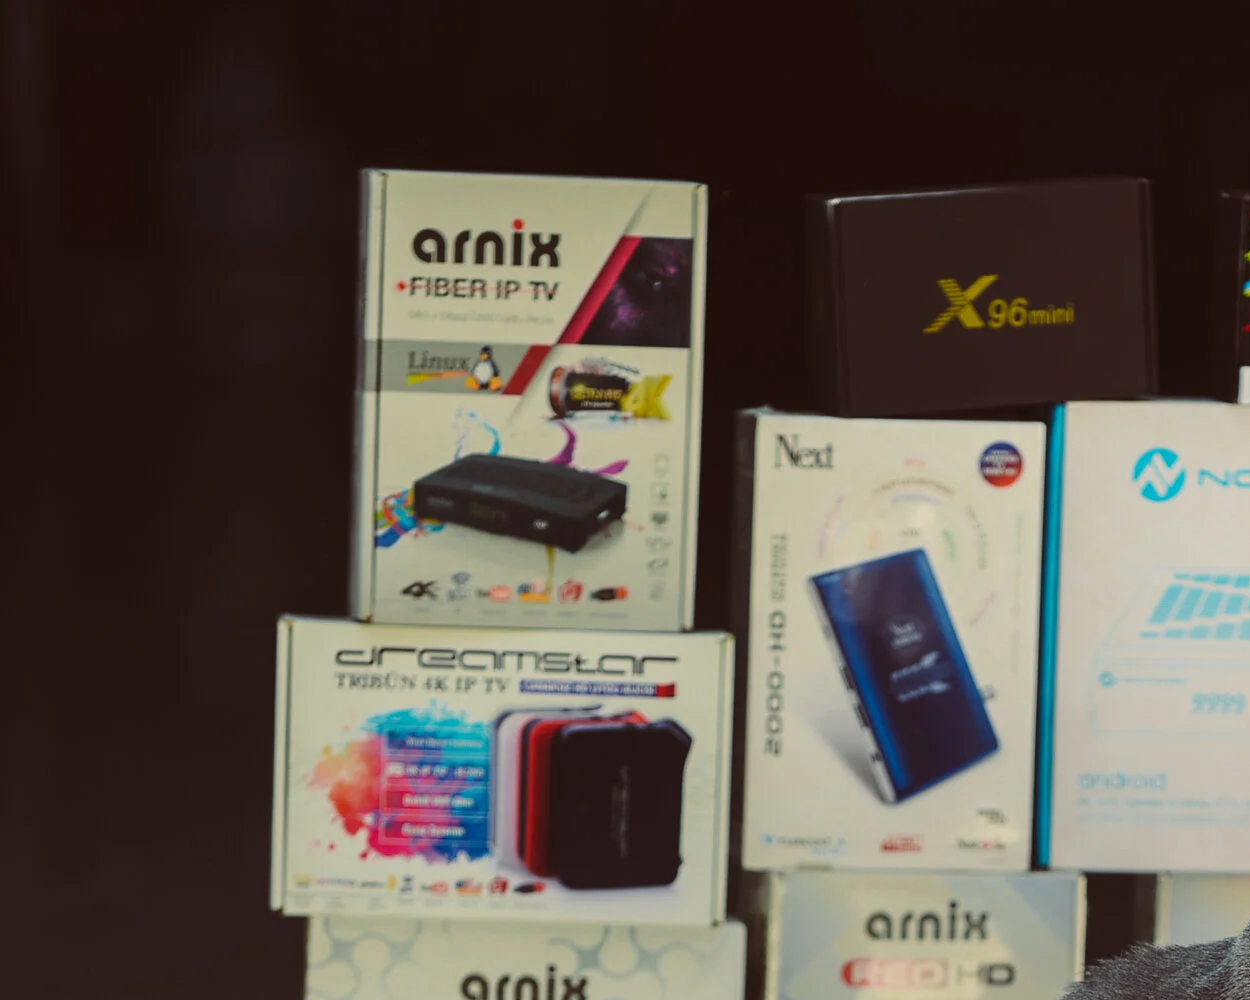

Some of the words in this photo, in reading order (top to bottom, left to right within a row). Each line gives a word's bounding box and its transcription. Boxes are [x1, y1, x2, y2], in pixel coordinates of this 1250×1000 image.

[413, 218, 562, 267] arnix
[408, 276, 488, 300] FIBER
[496, 278, 519, 300] IP
[530, 281, 560, 301] TV
[408, 350, 472, 371] Linux
[773, 434, 834, 471] Next
[335, 646, 679, 676] dreamstar
[423, 674, 449, 692] 4K
[455, 676, 478, 692] IP
[484, 677, 511, 694] TV
[865, 901, 990, 940] arnix
[958, 963, 1016, 986] HD
